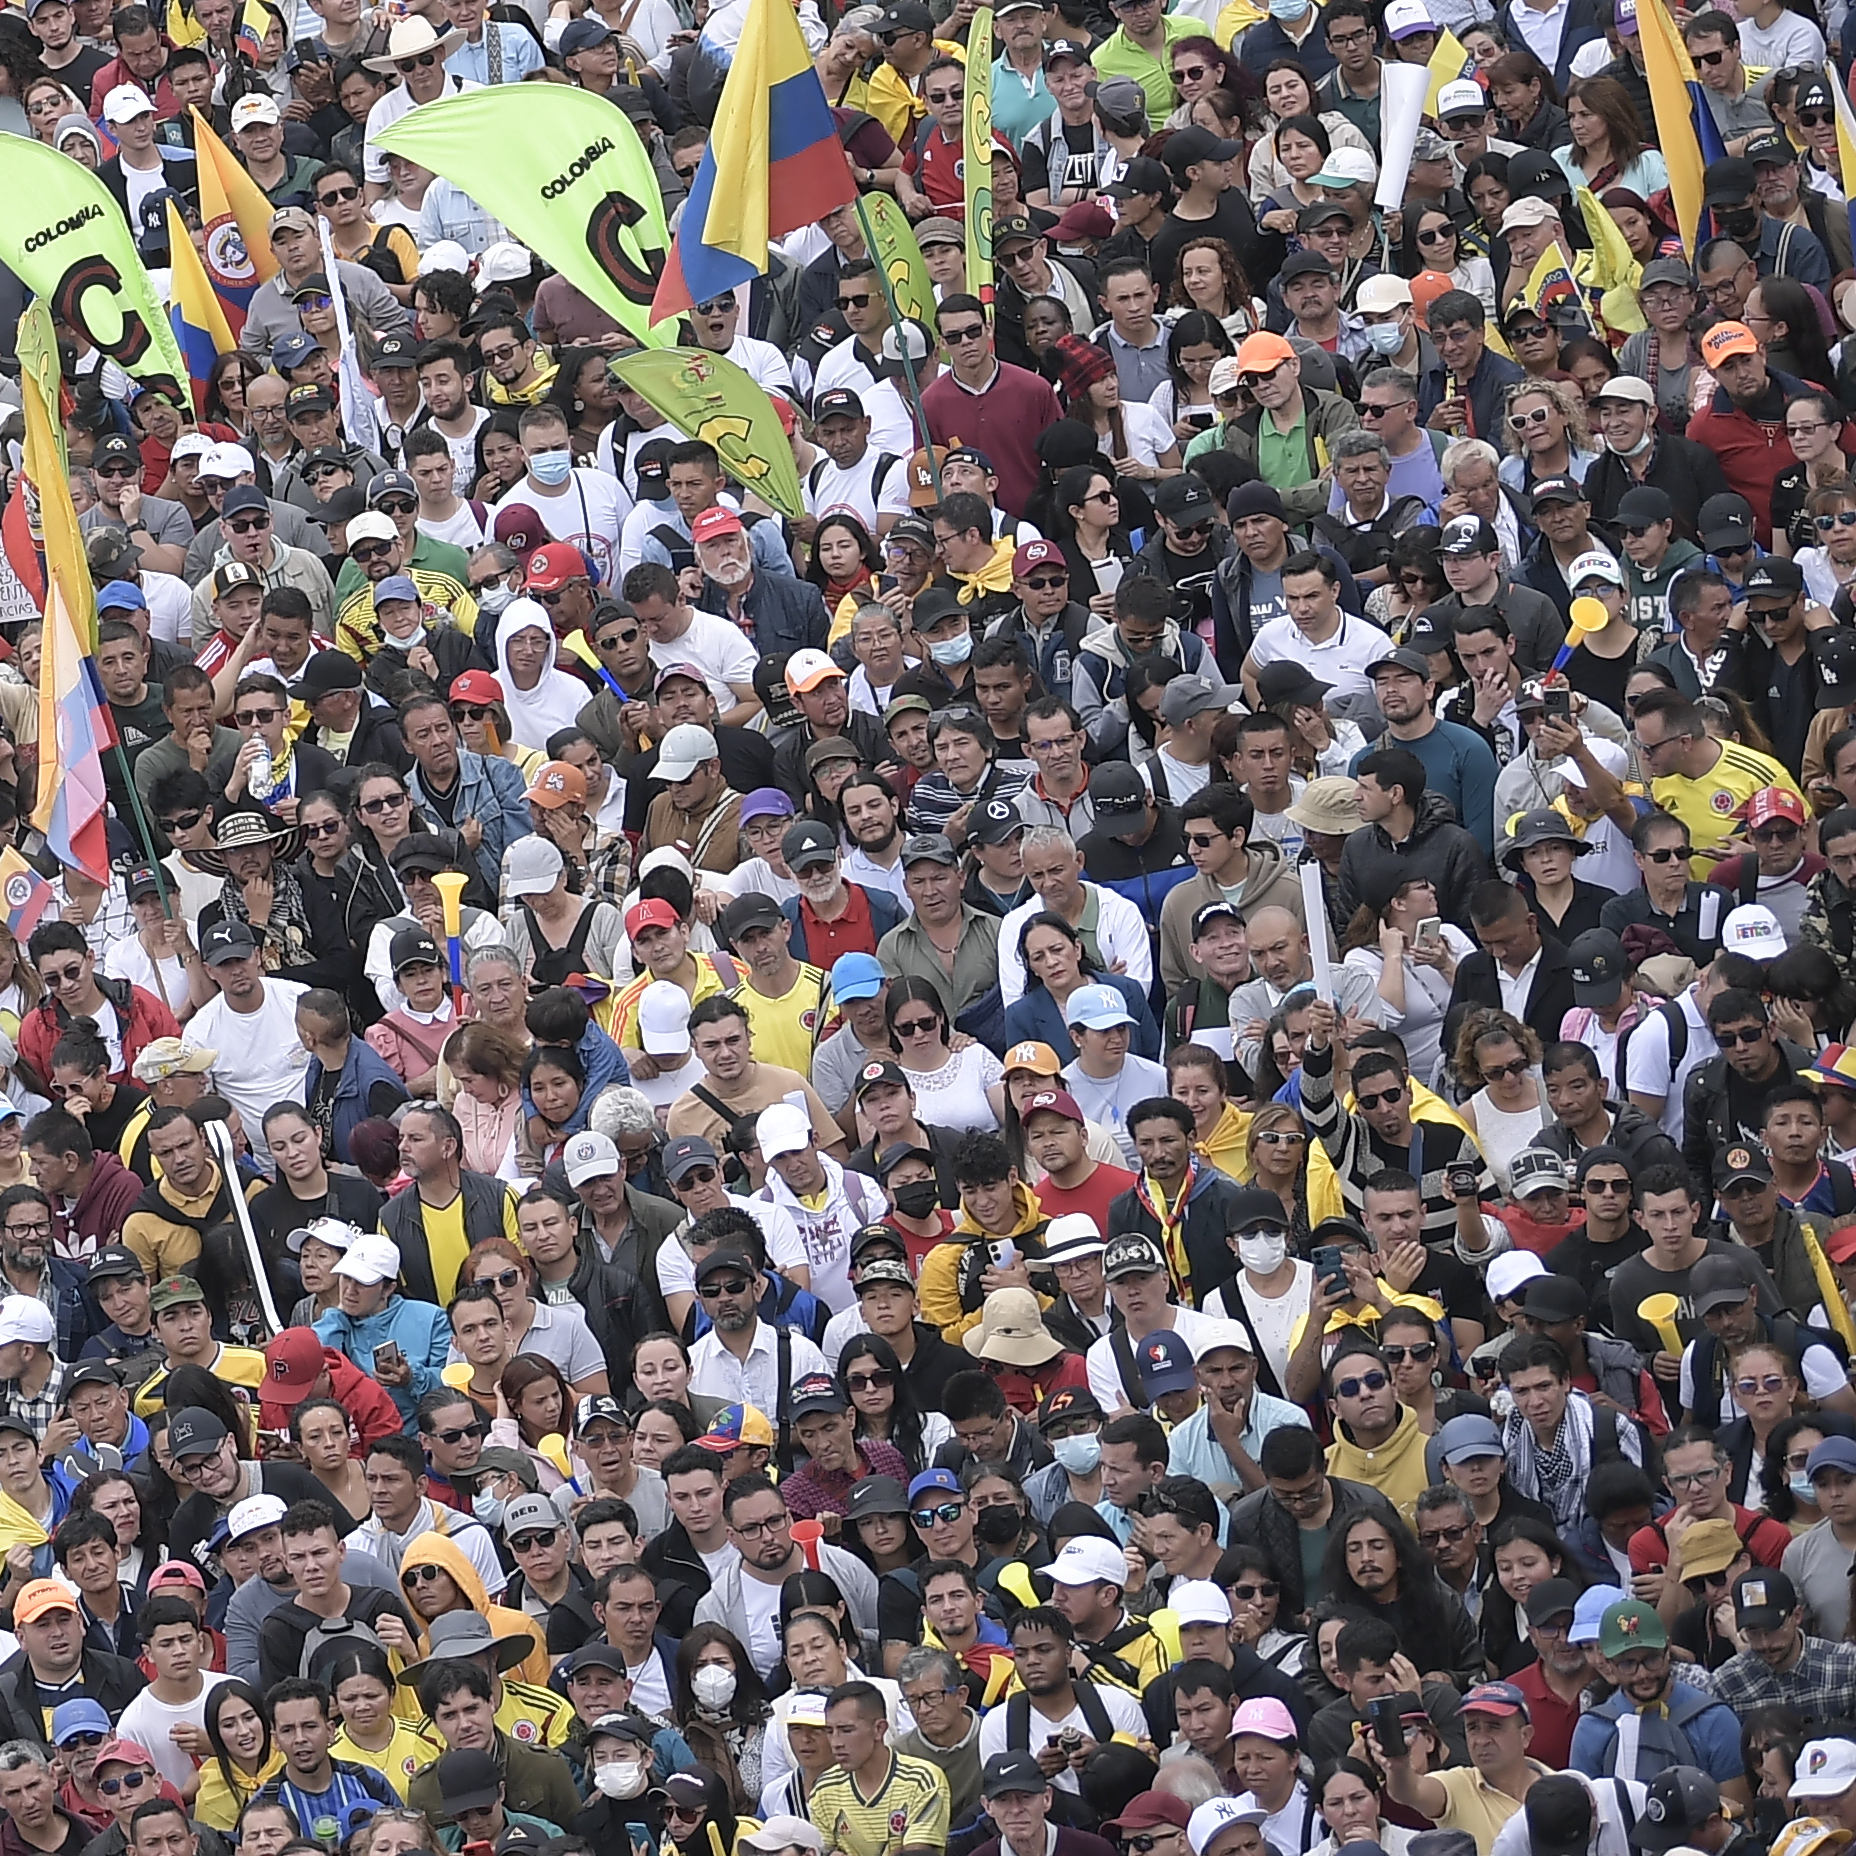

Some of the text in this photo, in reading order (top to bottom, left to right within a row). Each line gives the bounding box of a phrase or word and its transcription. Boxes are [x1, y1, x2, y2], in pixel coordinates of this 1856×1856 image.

[539, 136, 614, 200] COLOMBIA
[23, 203, 106, 254] COLOMBIA
[511, 1507, 538, 1521] RED
